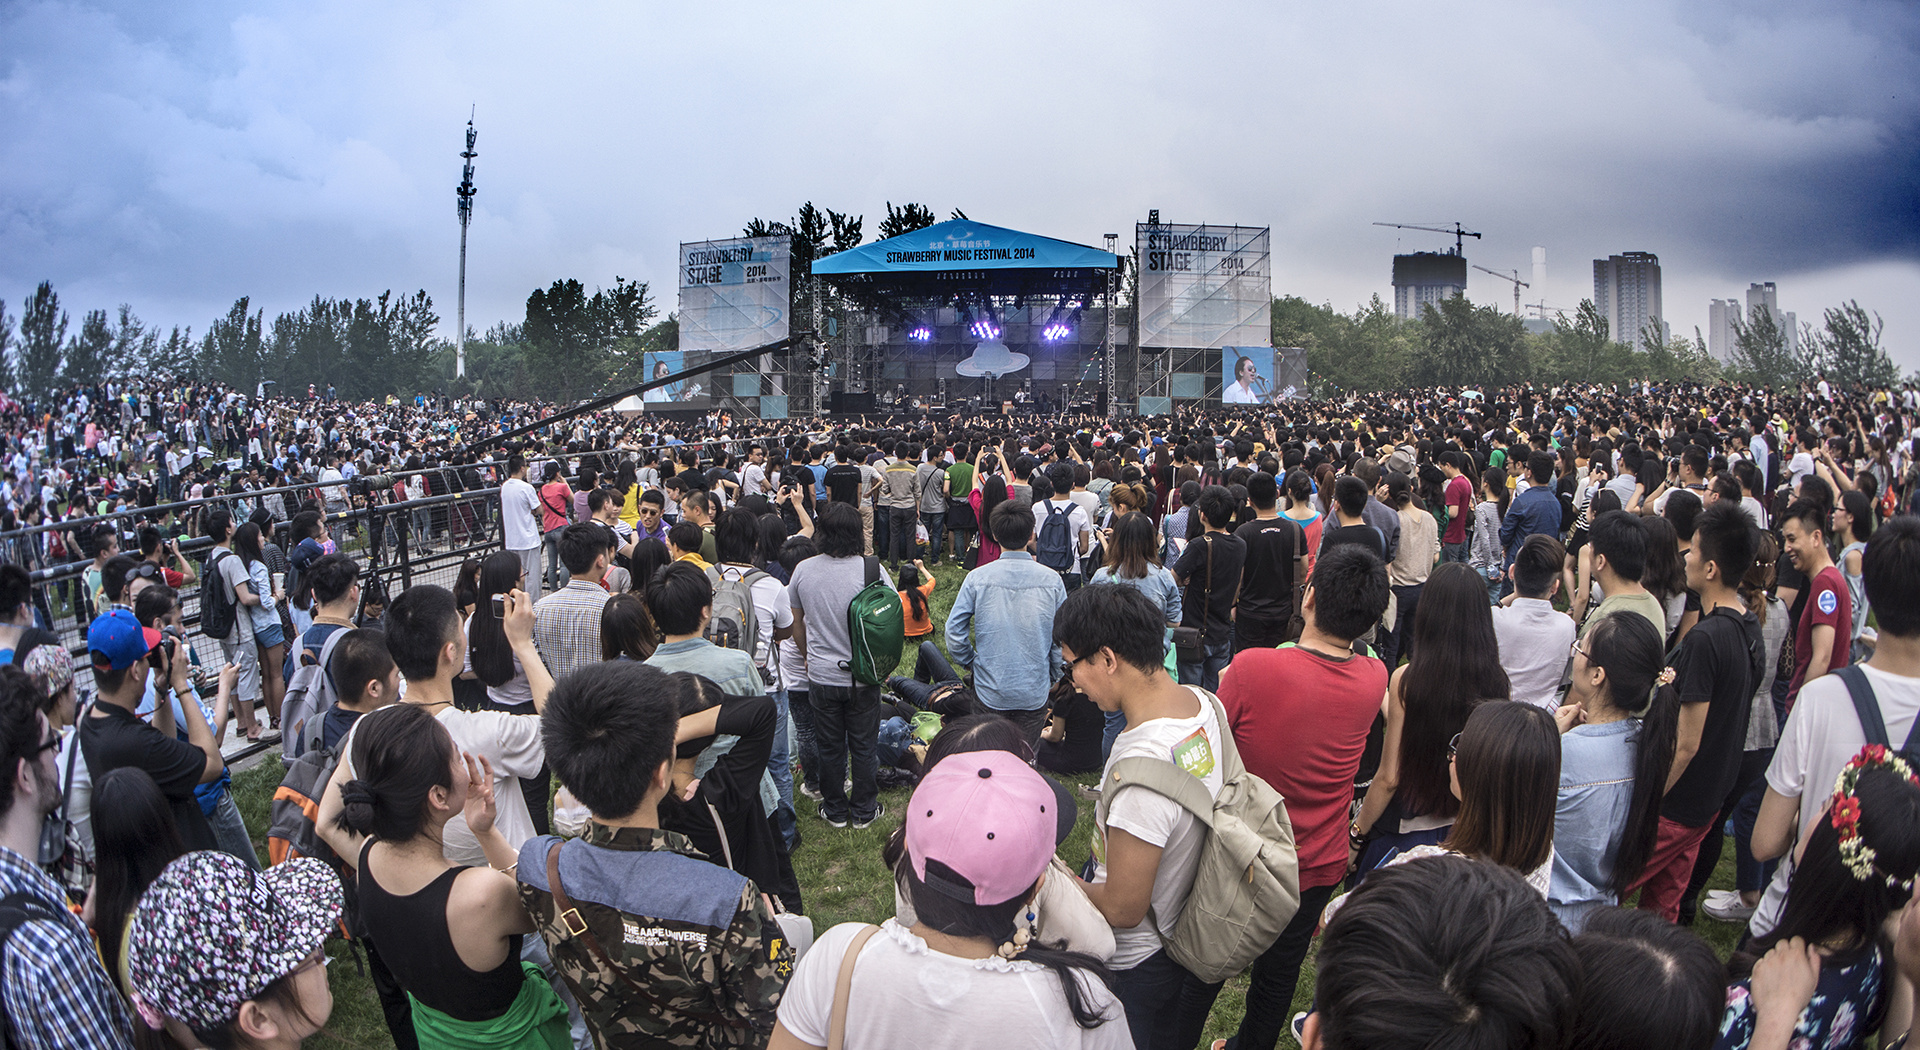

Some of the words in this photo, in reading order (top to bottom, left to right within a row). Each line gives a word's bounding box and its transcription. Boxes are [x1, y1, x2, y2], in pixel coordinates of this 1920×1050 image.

[1148, 234, 1228, 251] STRAWBERRY
[688, 247, 754, 266] STRAWBERRY
[886, 250, 942, 264] STRAWBERRY
[943, 249, 972, 262] MUSIC
[974, 248, 1012, 261] FESTIVAL
[1013, 247, 1035, 260] 2014
[1148, 251, 1192, 271] STAGE
[1221, 257, 1244, 270] 2014
[688, 265, 722, 285] STAGE
[746, 265, 767, 277] 2014
[623, 923, 640, 936] THE
[640, 927, 665, 937] AAPE
[665, 928, 708, 943] UNIVERSE
